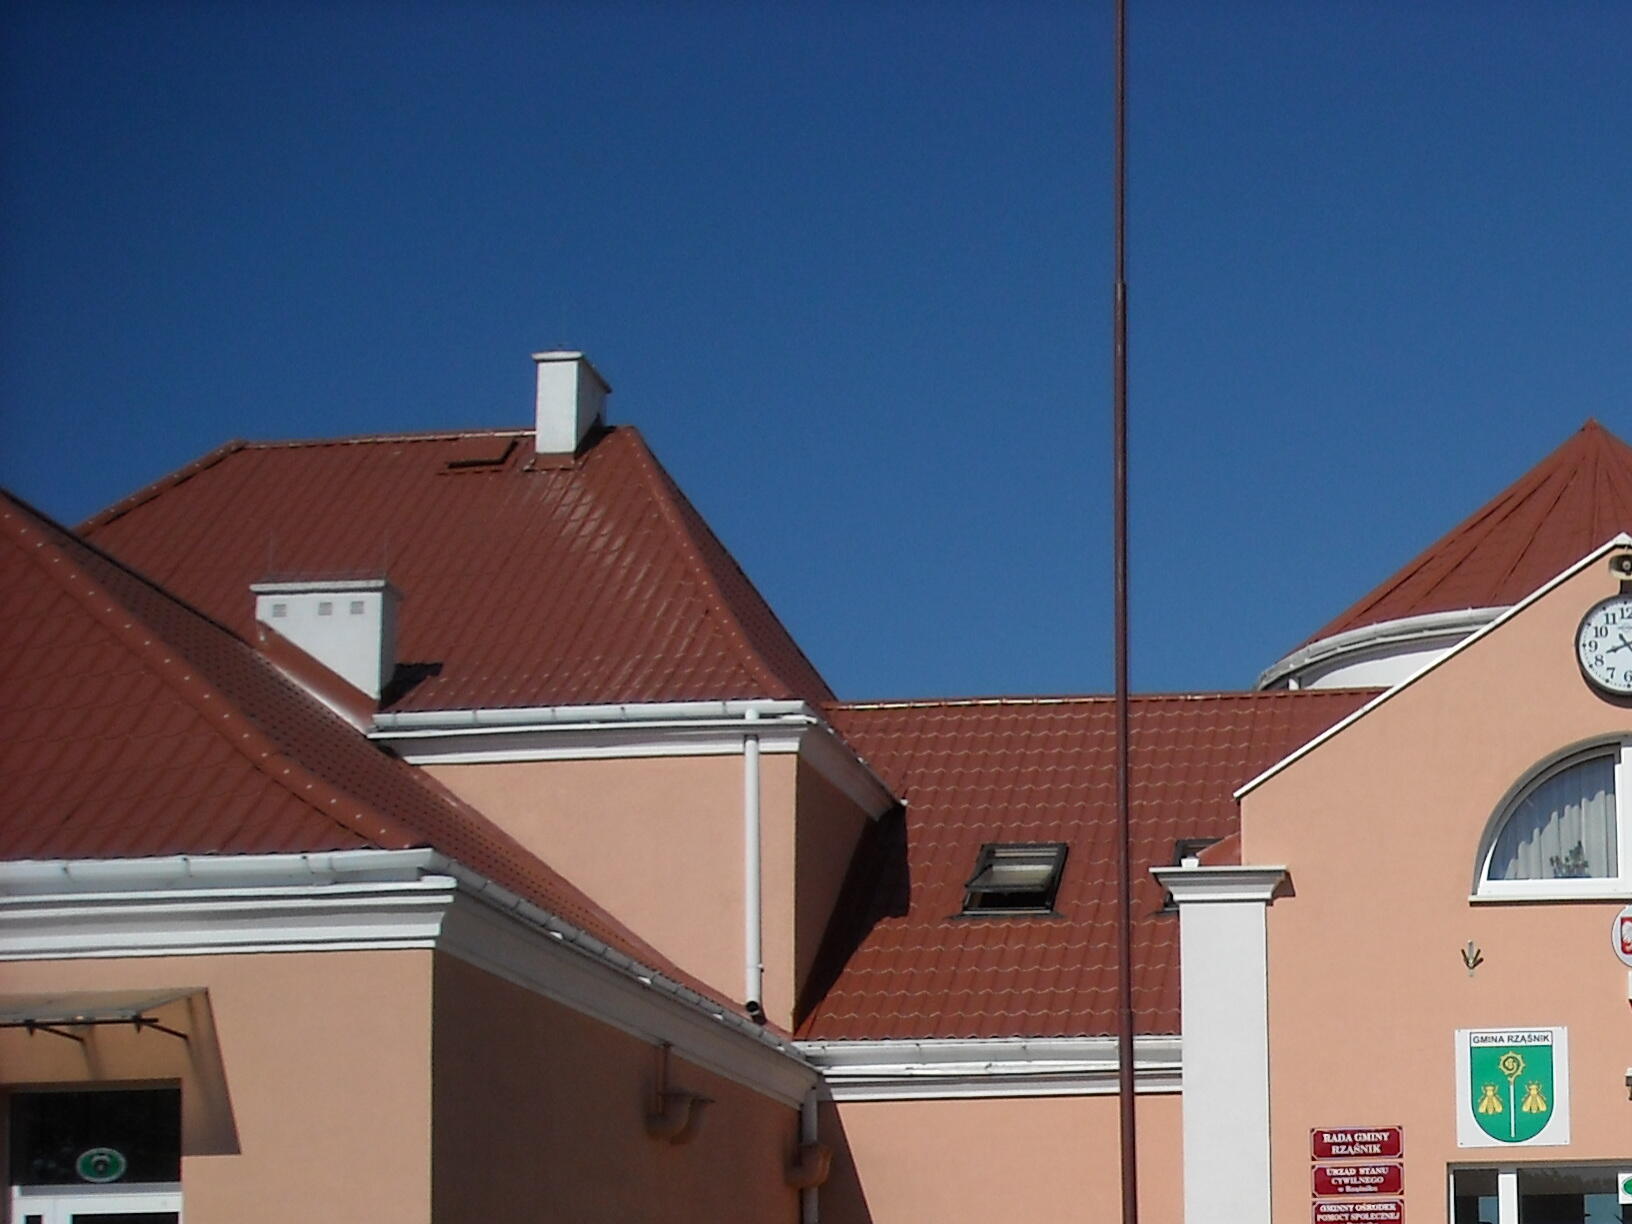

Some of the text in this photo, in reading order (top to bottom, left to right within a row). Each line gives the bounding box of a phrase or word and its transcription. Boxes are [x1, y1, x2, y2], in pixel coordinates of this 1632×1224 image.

[1605, 613, 1617, 625] 11
[1594, 626, 1608, 638] 10
[1588, 640, 1598, 652] 9
[1594, 655, 1604, 666] 8
[1606, 667, 1616, 679] 7
[1624, 670, 1632, 682] 6
[1473, 1034, 1550, 1044] GMINA RZĄŚNIK
[1323, 1132, 1390, 1143] RADA GMINY
[1331, 1142, 1381, 1155] RZĄŚNIK
[1359, 1167, 1389, 1175] STANU
[1331, 1176, 1384, 1185] CYWILNEGO
